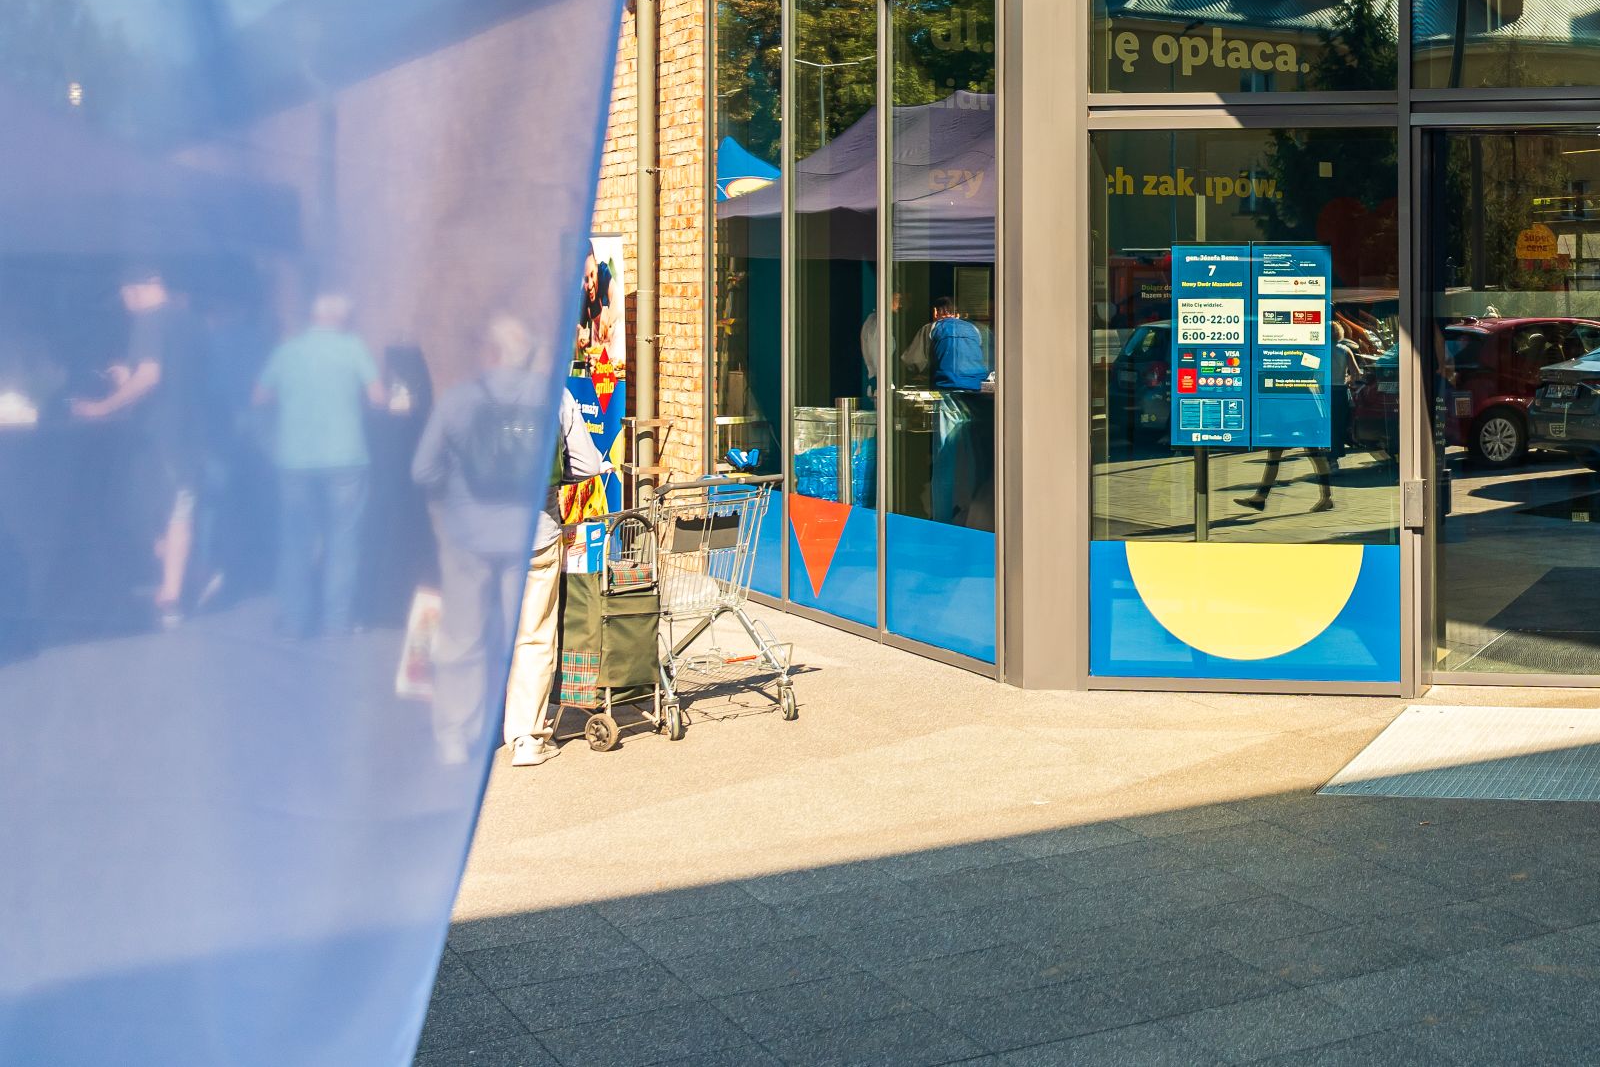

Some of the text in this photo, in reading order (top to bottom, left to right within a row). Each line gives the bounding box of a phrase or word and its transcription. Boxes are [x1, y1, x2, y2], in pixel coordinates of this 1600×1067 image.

[1152, 28, 1310, 76] opłaca.
[1208, 265, 1217, 276] 7
[1182, 315, 1240, 324] 6:00-22:00
[1182, 331, 1240, 341] 6:00-22:00
